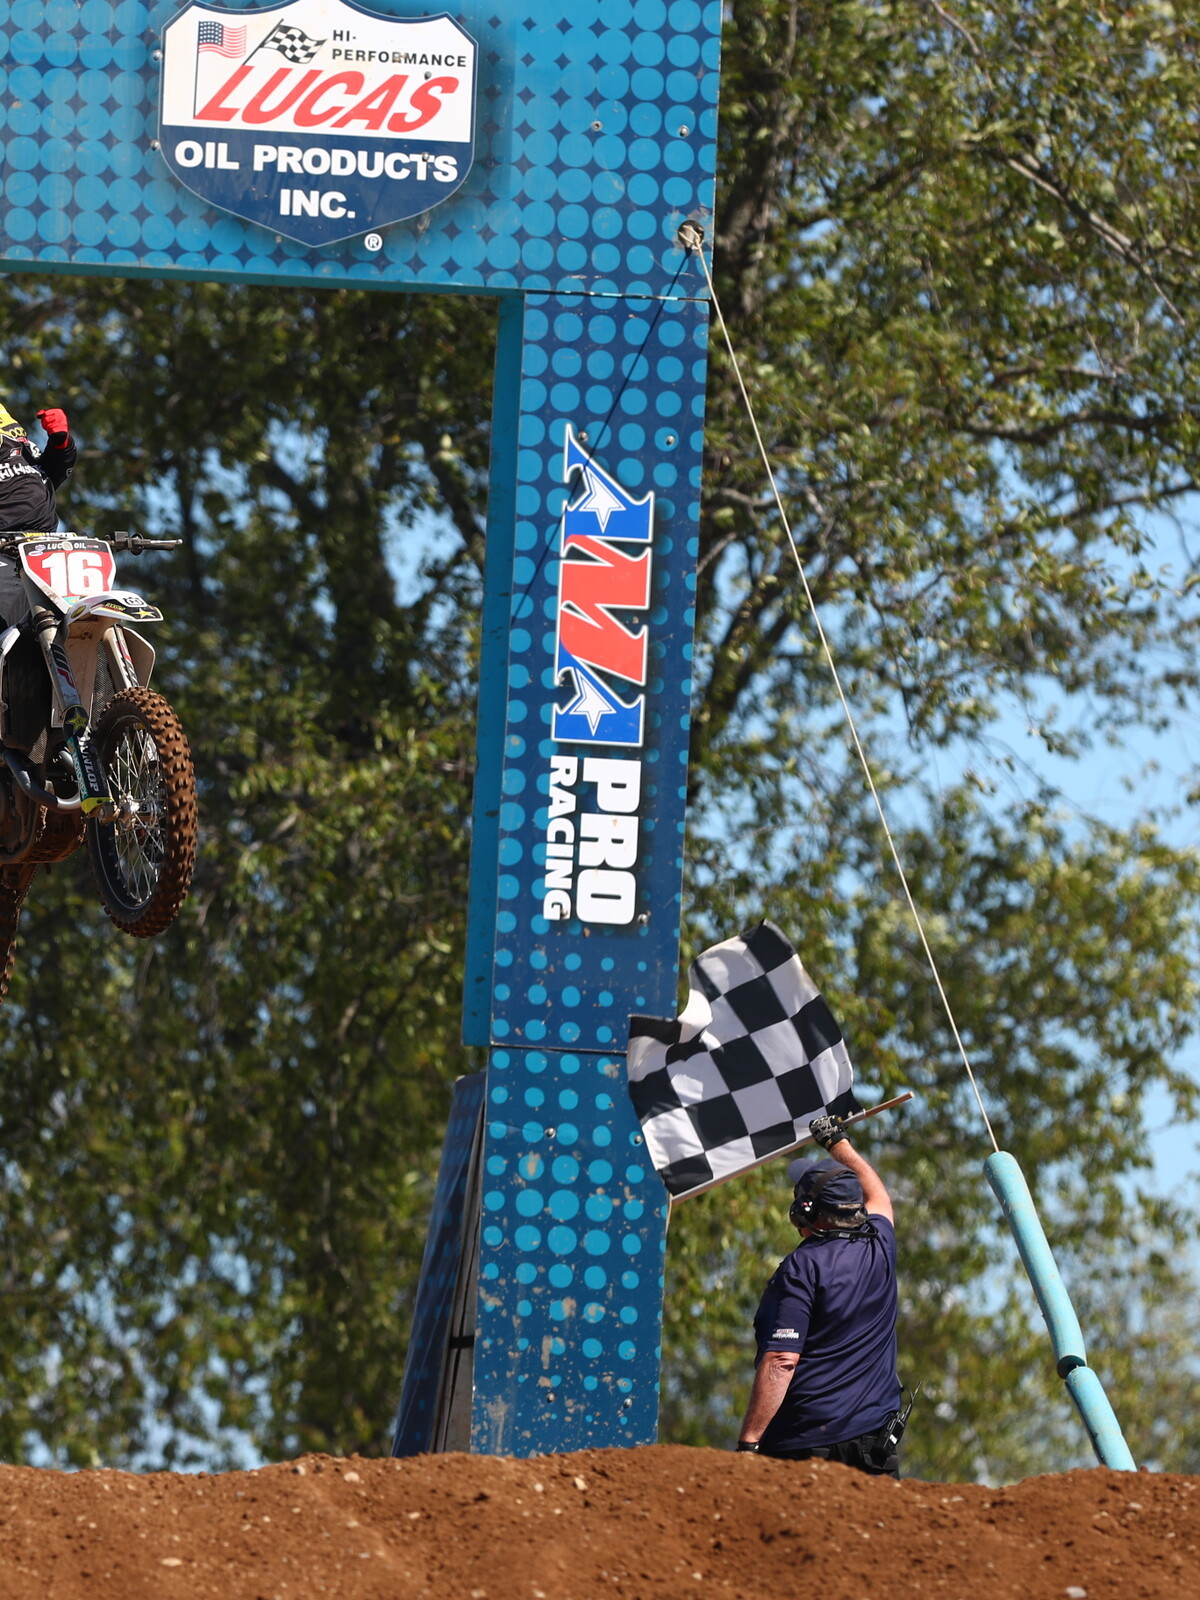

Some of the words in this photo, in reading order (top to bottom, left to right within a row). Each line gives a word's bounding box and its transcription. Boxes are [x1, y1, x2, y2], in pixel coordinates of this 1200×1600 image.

[331, 48, 467, 68] PERFORMANCE
[332, 29, 357, 42] HI-
[193, 65, 459, 132] LUCAS
[174, 140, 240, 170] OIL
[253, 144, 458, 183] PRODUCTS
[279, 188, 356, 219] INC.
[41, 552, 104, 598] 16
[550, 423, 655, 746] AMA
[543, 755, 578, 920] RACING
[576, 757, 642, 925] PRO
